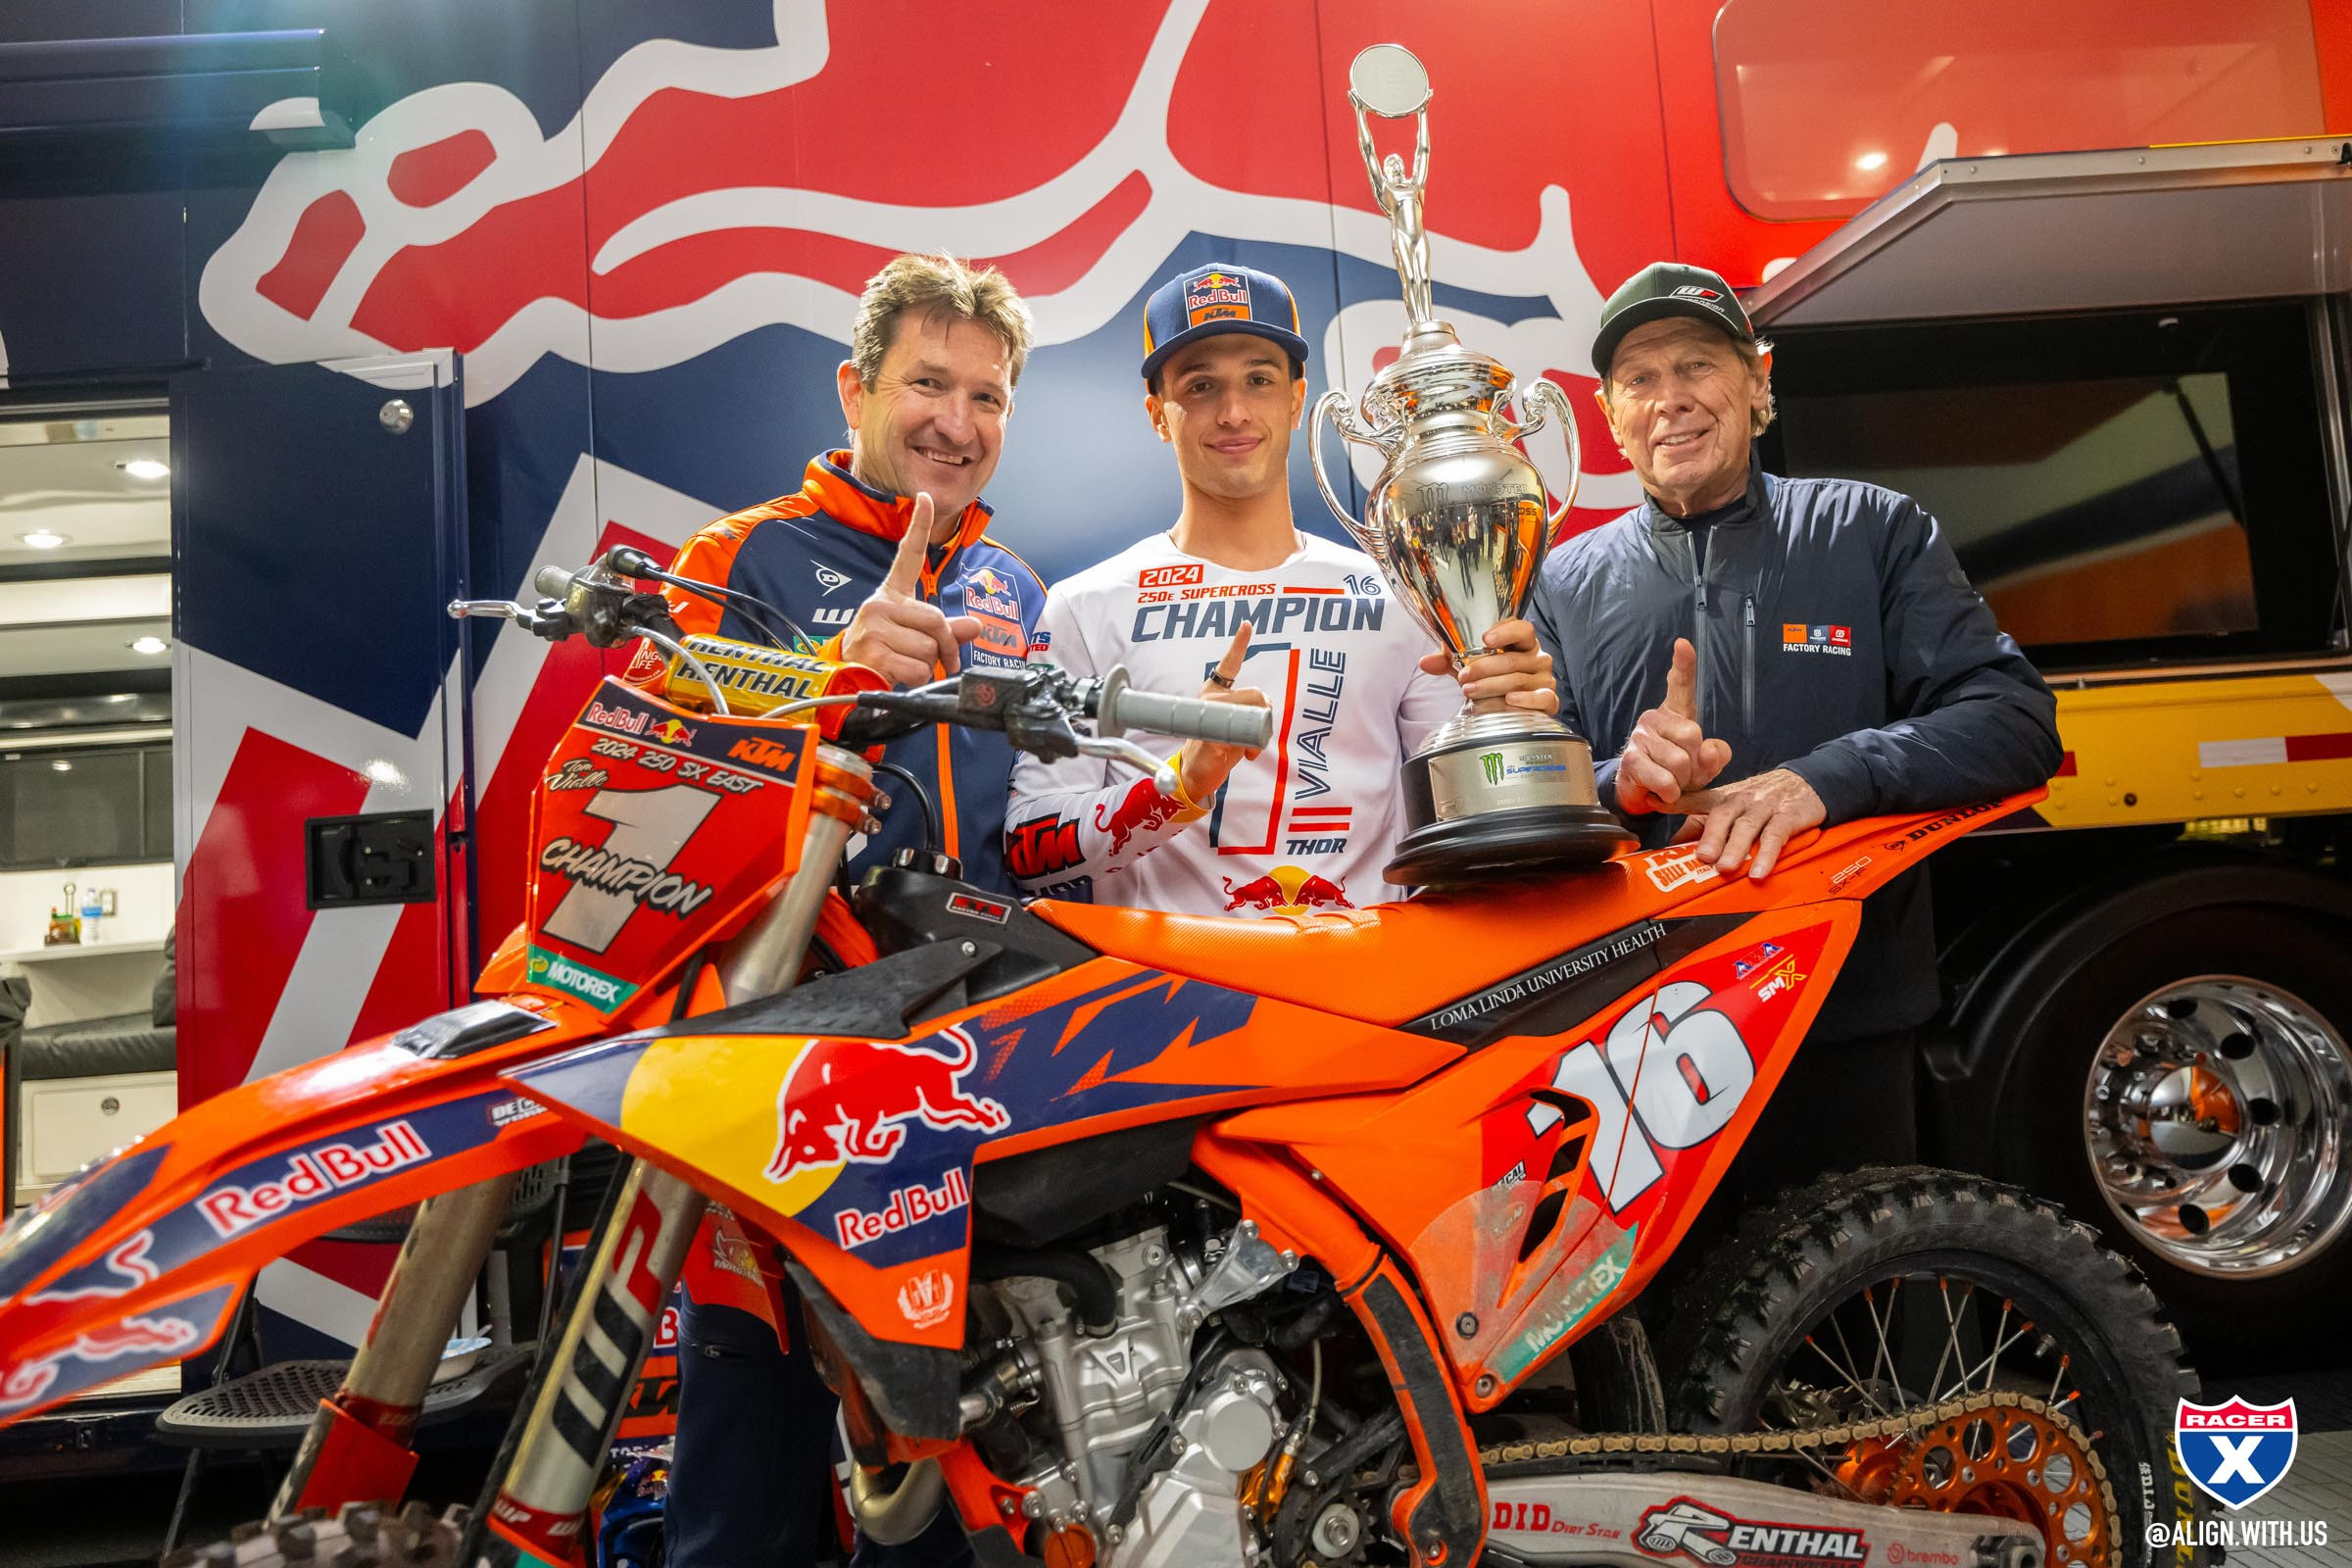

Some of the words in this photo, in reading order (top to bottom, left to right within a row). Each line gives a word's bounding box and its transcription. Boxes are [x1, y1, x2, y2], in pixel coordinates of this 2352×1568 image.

[1202, 308, 1237, 321] KTM
[1143, 565, 1200, 587] 2024
[1343, 573, 1382, 596] 16
[1180, 583, 1277, 601] SUPERCROSS
[1130, 597, 1385, 643] CHAMPION
[980, 623, 1017, 648] KTM
[1783, 643, 1821, 654] FACTORY
[1822, 645, 1851, 657] RACING
[973, 650, 1001, 667] FACTORY
[1003, 657, 1026, 670] RACIN
[673, 662, 813, 700] RENTHAL
[1295, 648, 1347, 800] VIALLE
[562, 759, 594, 773] Tom
[590, 737, 639, 760] 2024
[638, 751, 677, 771] 250
[676, 760, 710, 781] SX
[706, 769, 765, 794] EAST
[726, 736, 797, 772] KTM
[1286, 838, 1348, 857] THOR
[539, 783, 724, 956] 1
[540, 837, 713, 921] CHAMPION
[1829, 866, 1866, 896] SX-F
[1831, 856, 1872, 884] 250
[547, 959, 620, 1004] MOTOREX
[1431, 1002, 1480, 1031] LOMA
[1478, 984, 1527, 1013] LINDA
[1527, 947, 1610, 994] UNIVERSITY
[1611, 922, 1667, 958] HEALTH
[1524, 980, 1757, 1216] 16
[1907, 1550, 1959, 1566] brembo
